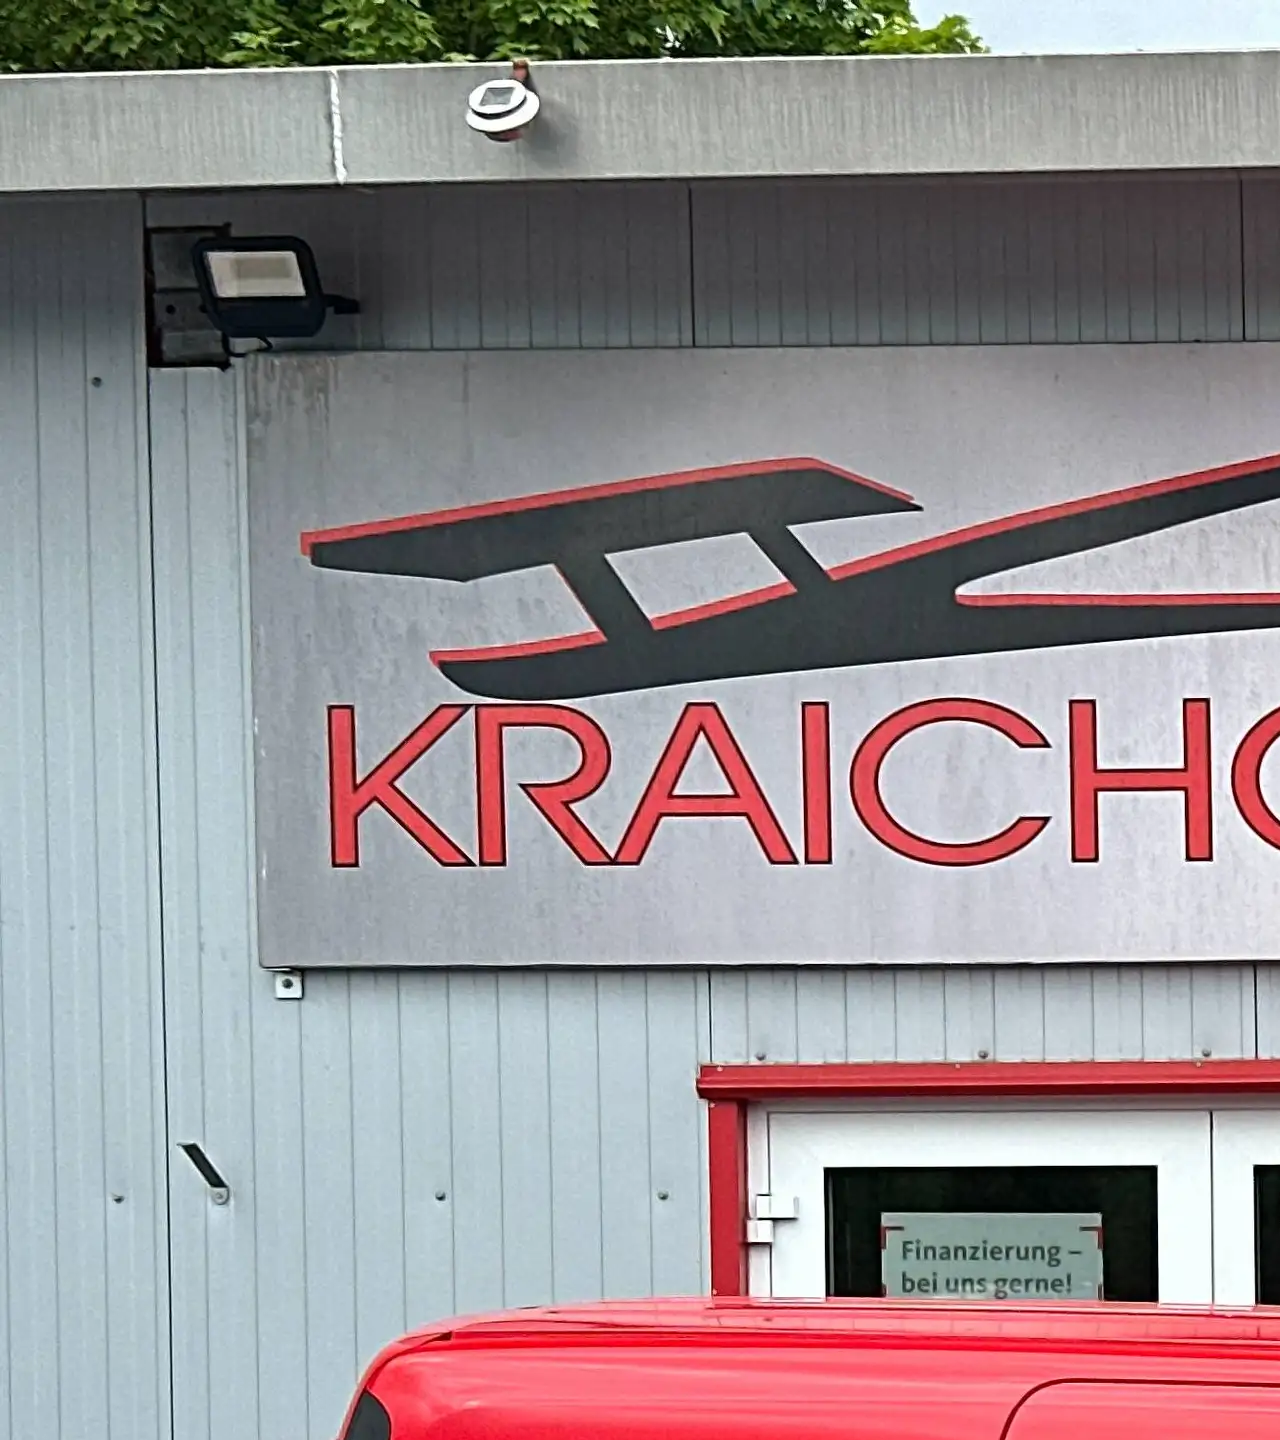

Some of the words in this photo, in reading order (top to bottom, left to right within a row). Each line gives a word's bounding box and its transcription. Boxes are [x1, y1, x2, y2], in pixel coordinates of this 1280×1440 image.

[901, 1239, 1062, 1268] Finanzierung
[901, 1271, 939, 1293] bei
[945, 1276, 987, 1294] uns
[993, 1273, 1073, 1300] gerne!
